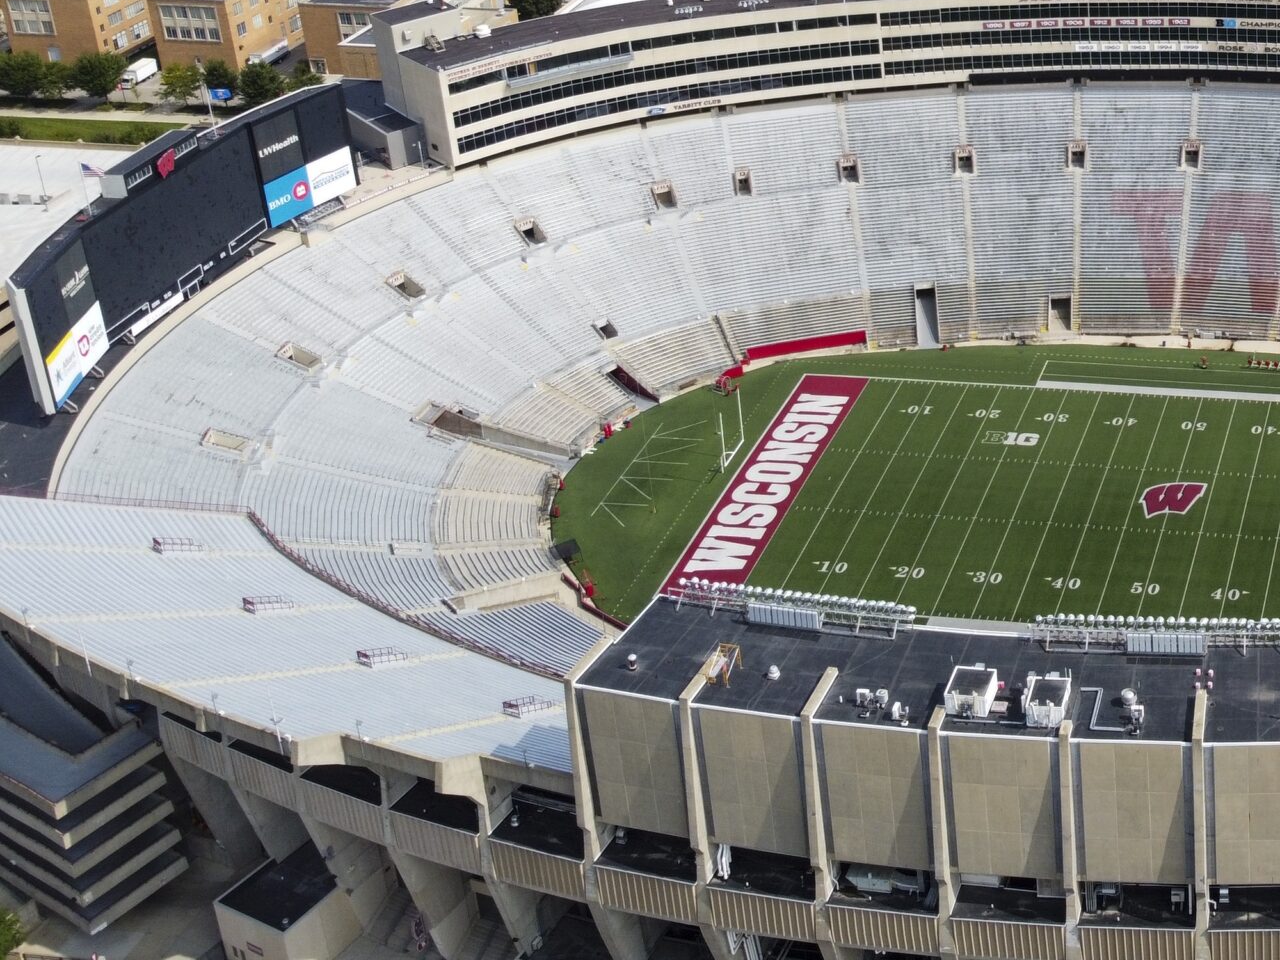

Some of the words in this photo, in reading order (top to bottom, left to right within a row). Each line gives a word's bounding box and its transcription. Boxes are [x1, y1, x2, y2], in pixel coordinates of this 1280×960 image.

[673, 101, 702, 111] VARSITY
[269, 194, 291, 211] BMO
[907, 405, 934, 415] 10
[975, 409, 1002, 419] 20
[1043, 413, 1070, 423] 30
[1112, 416, 1138, 427] 40
[1181, 421, 1207, 431] 50
[1251, 425, 1277, 435] 40
[682, 393, 850, 573] WISCONSIN
[1138, 482, 1208, 519] W
[817, 560, 848, 574] 10
[894, 565, 925, 579] 20
[972, 570, 1003, 585] 30
[1051, 576, 1081, 590] 40
[1130, 581, 1161, 595] 50
[1210, 587, 1241, 601] 40
